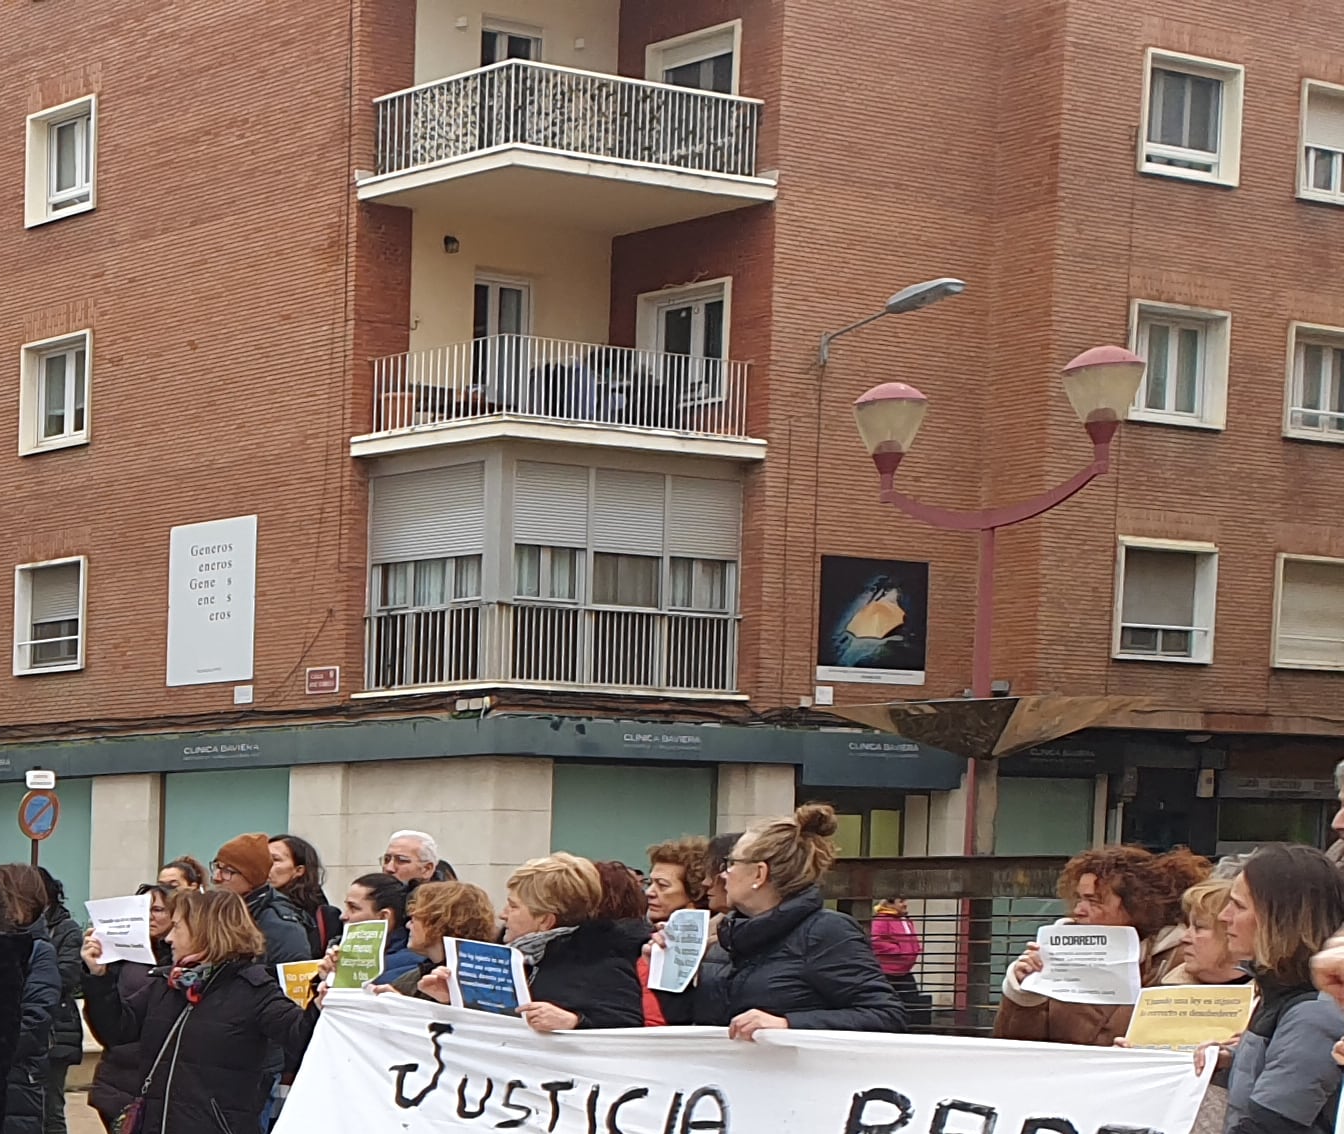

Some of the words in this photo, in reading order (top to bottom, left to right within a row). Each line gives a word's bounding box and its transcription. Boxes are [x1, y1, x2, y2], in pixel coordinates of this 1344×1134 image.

[190, 543, 233, 556] Generos
[198, 560, 232, 572] eneros
[189, 578, 216, 590] Gene
[197, 595, 215, 605] ene
[226, 593, 232, 602] s
[209, 611, 231, 621] eros
[1049, 935, 1061, 946] LO
[1061, 935, 1107, 946] CORRECTO
